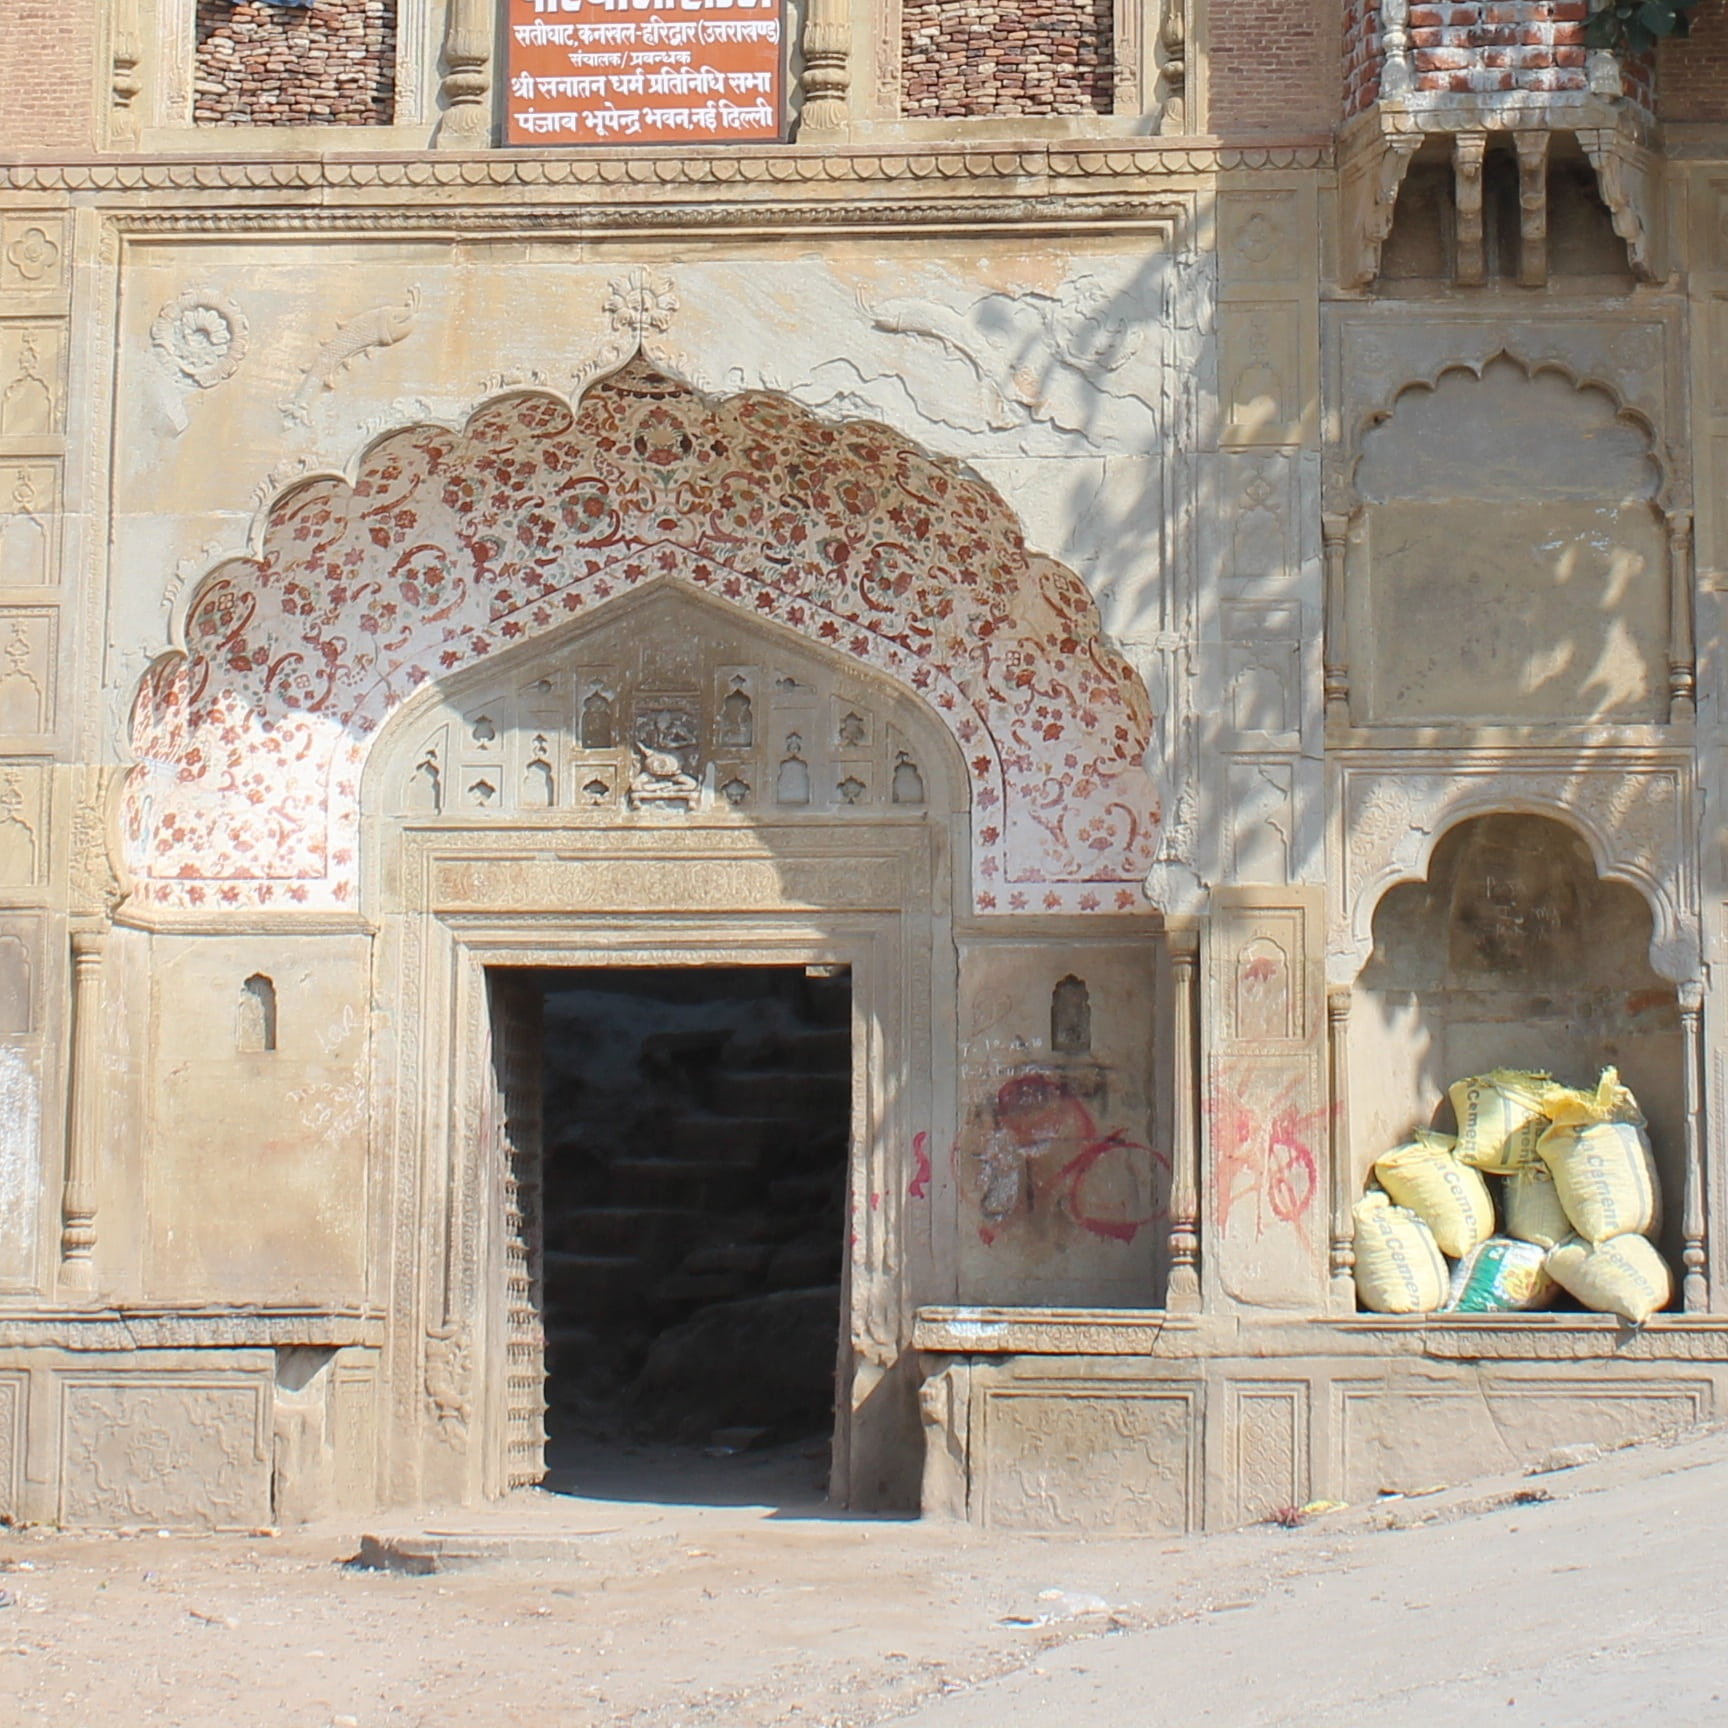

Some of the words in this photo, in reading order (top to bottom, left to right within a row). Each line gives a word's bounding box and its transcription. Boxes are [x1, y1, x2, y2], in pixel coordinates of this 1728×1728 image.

[511, 70, 535, 100] श्री
[535, 76, 607, 100] सनातन
[608, 67, 646, 96] धर्म
[645, 65, 726, 95] प्रतिनिधि
[726, 71, 772, 95] सभा
[581, 101, 643, 136] भूपेन्द्र
[718, 97, 774, 131] दिल्ली
